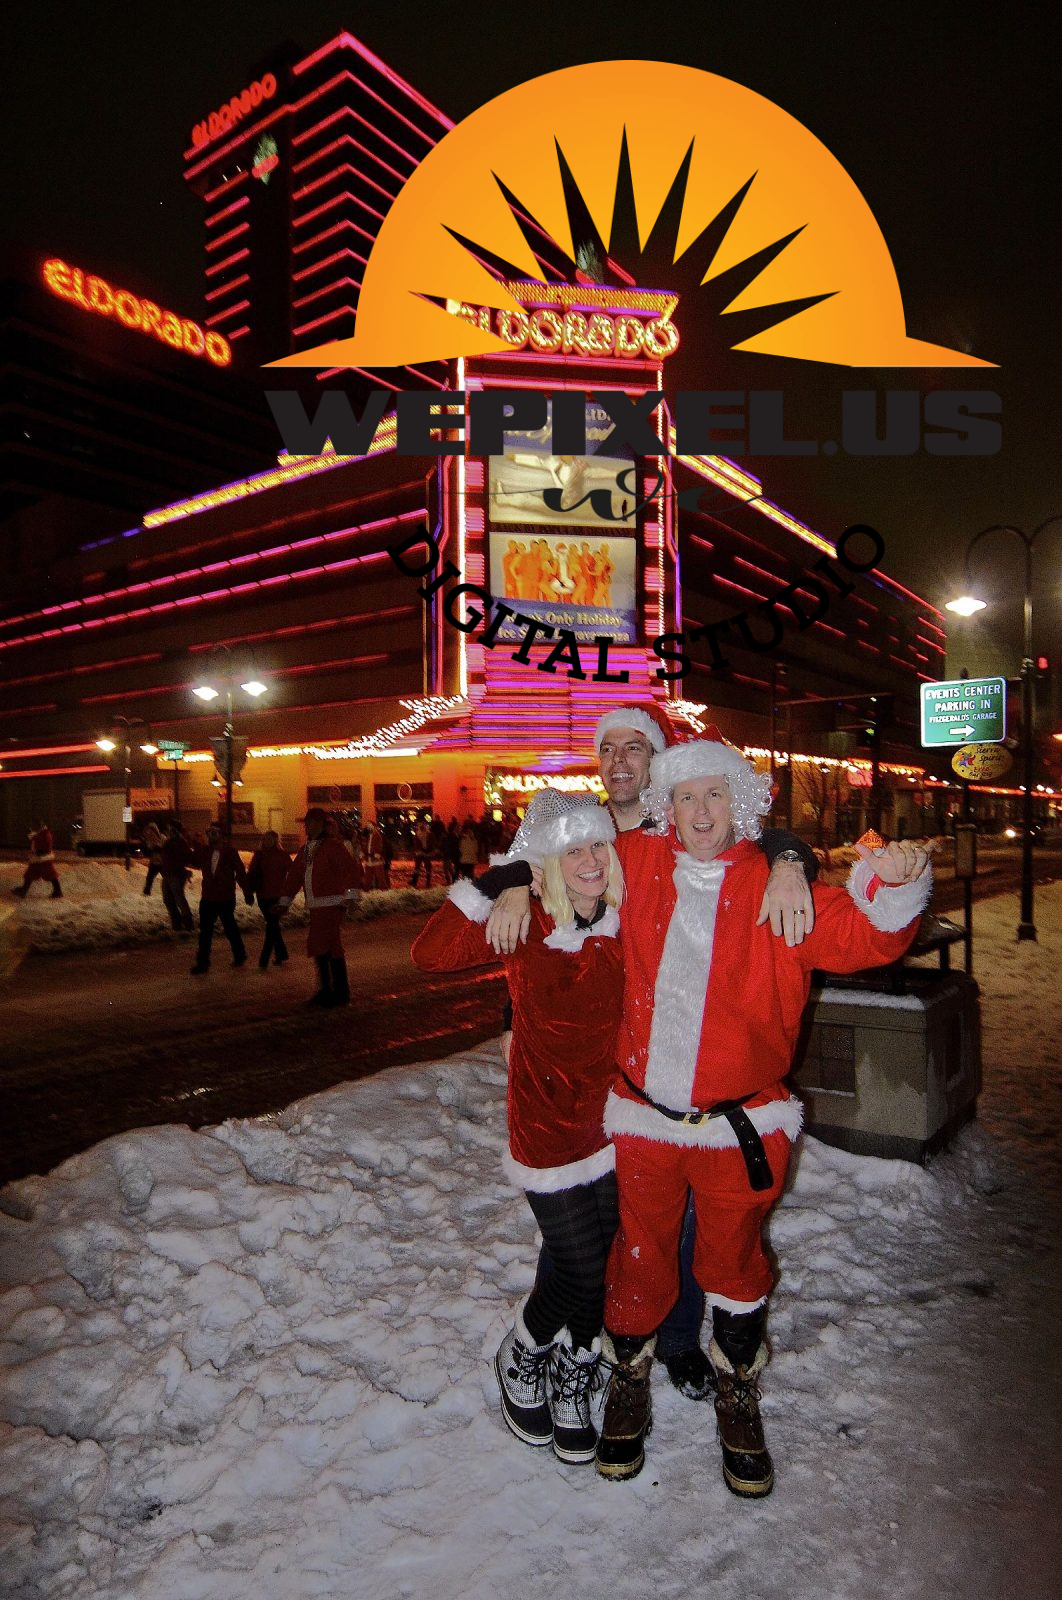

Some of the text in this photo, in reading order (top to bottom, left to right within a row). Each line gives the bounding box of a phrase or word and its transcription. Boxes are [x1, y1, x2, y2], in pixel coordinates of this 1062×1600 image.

[577, 612, 622, 627] Holiday
[925, 685, 1001, 700] EVENTS CENTER
[934, 699, 991, 713] PARKING IN
[972, 712, 998, 721] GARAGE
